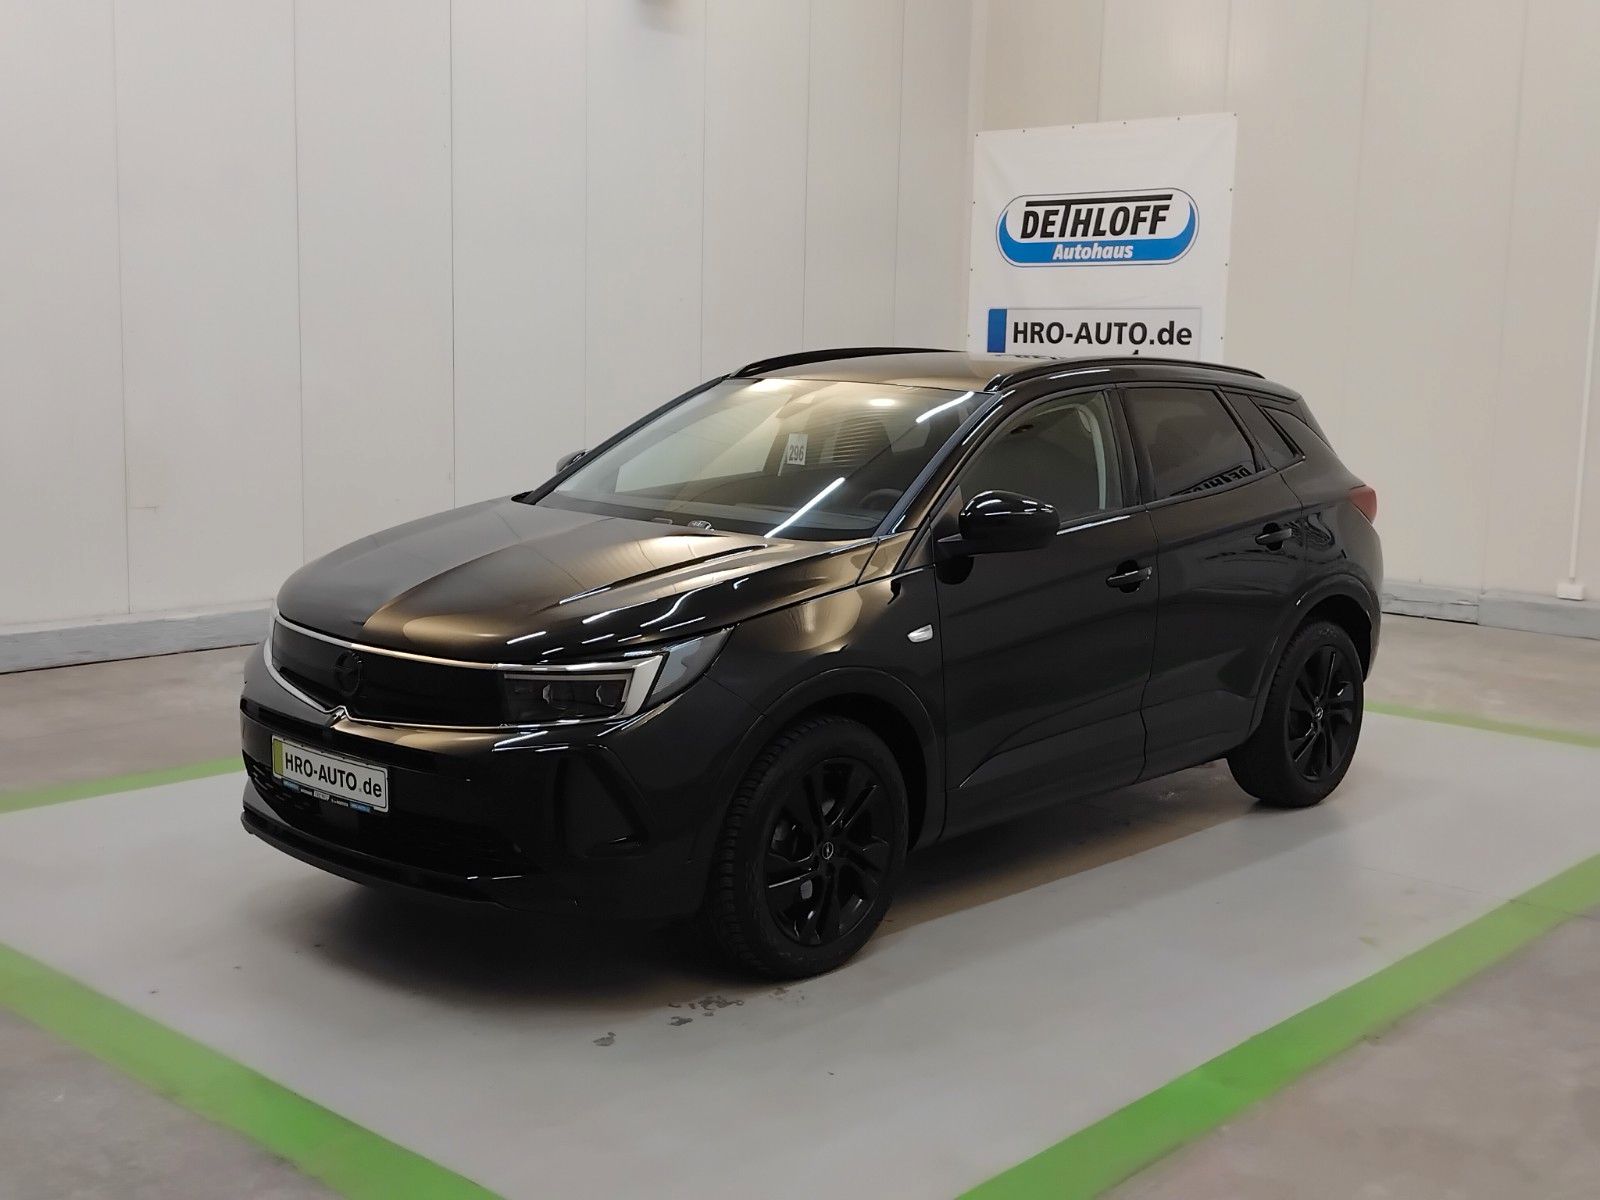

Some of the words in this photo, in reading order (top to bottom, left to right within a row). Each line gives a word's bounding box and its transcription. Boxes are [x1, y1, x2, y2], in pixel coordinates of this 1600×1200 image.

[1020, 194, 1173, 239] DETHLOFF
[1052, 242, 1134, 261] Autohaus
[1013, 320, 1193, 345] HRO-AUTO.de
[788, 444, 805, 462] 296
